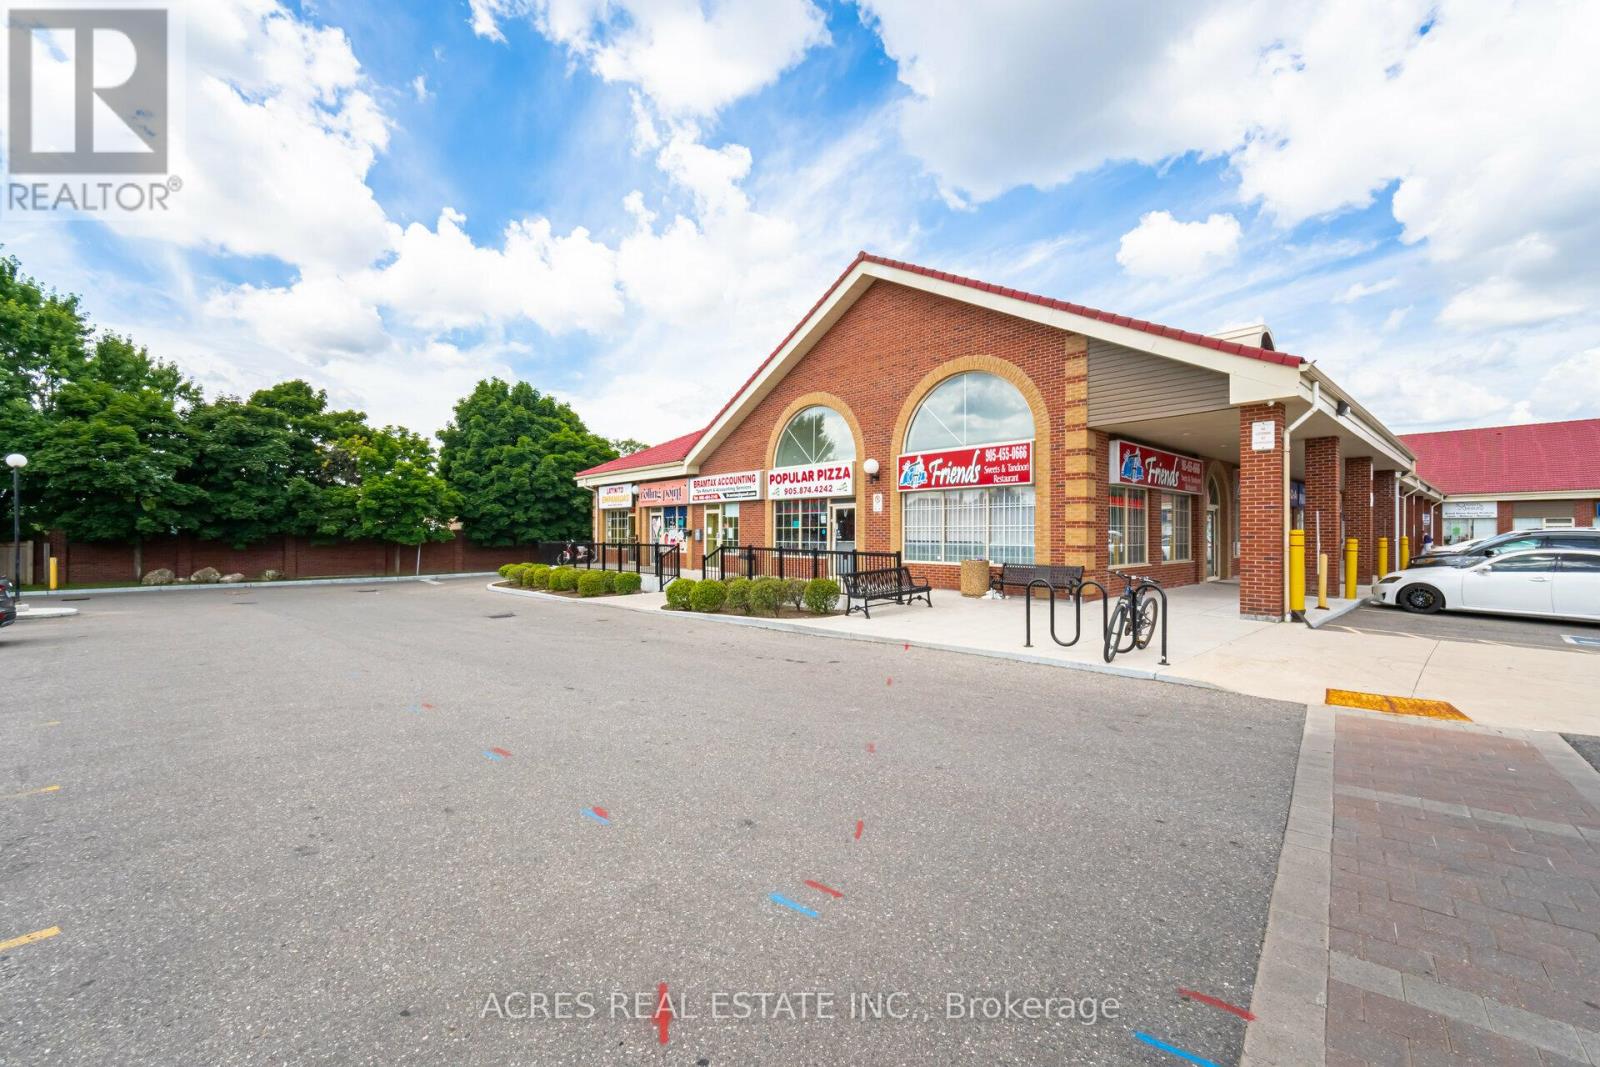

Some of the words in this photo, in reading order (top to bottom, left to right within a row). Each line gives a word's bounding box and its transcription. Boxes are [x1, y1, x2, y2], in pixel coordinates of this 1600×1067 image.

[929, 448, 981, 486] Friends
[984, 465, 1001, 474] Sweets
[1145, 456, 1180, 487] Friends
[693, 478, 717, 489] BRAMTAX
[718, 474, 756, 486] ACCOUNTING
[769, 470, 815, 485] POPULAR
[817, 467, 851, 481] PIZZA
[993, 475, 1019, 484] Restaurant
[784, 485, 833, 495] 905.874.4242
